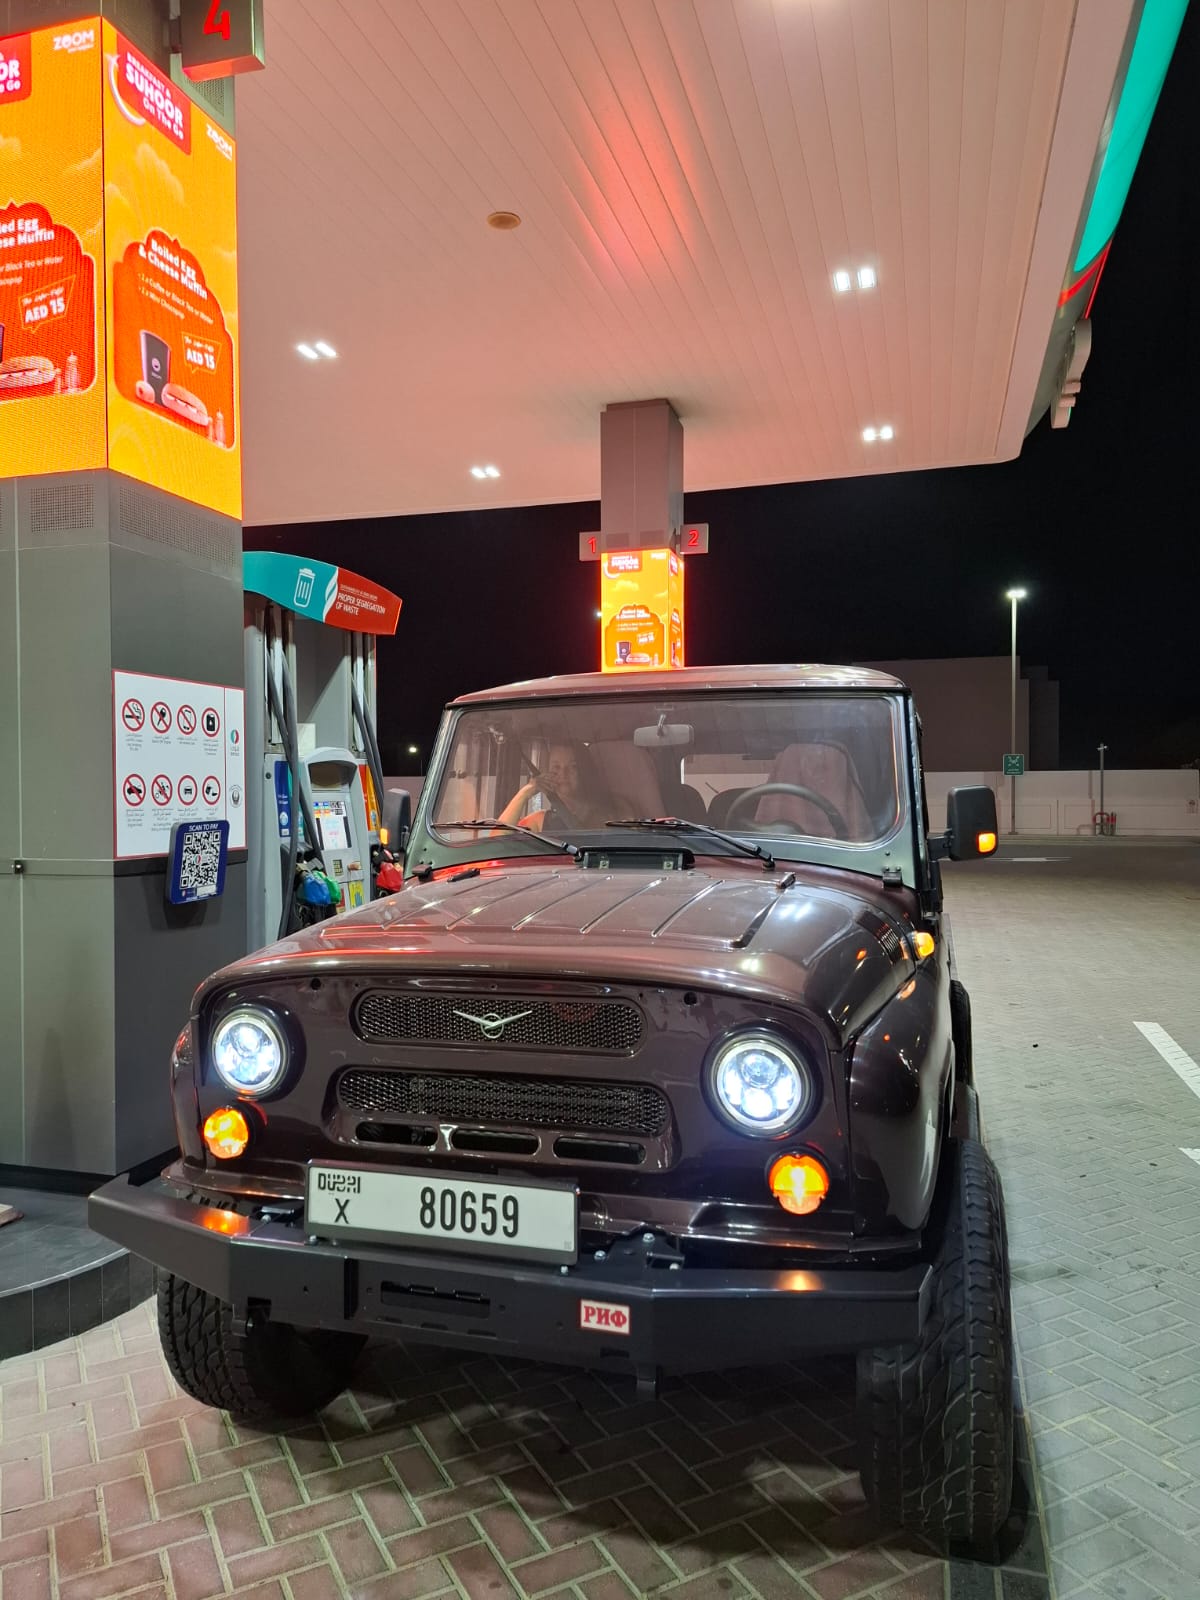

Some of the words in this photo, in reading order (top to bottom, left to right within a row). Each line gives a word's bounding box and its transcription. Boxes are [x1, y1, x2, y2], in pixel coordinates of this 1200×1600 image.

[203, 0, 230, 40] 4
[53, 30, 94, 51] ZOOM
[6, 79, 21, 91] Go
[126, 62, 183, 128] SUHOOR
[143, 97, 155, 117] On
[156, 107, 172, 129] The
[173, 123, 184, 140] Go
[206, 122, 233, 155] ZOOM
[17, 218, 39, 233] Egg
[17, 228, 55, 246] Muffin
[151, 238, 179, 268] Boiled
[180, 258, 196, 282] Egg
[147, 250, 179, 281] Cheese
[181, 272, 208, 300] Muffin
[25, 304, 48, 323] AED
[49, 296, 65, 315] 15
[186, 347, 204, 366] AED
[204, 351, 216, 370] 15
[588, 536, 597, 554] 1
[688, 529, 699, 547] 2
[335, 601, 344, 610] OF
[343, 603, 359, 616] WASTE
[338, 592, 356, 605] PROPER
[334, 1198, 350, 1224] X
[420, 1186, 519, 1238] 80659
[584, 1305, 627, 1328] РИФ
